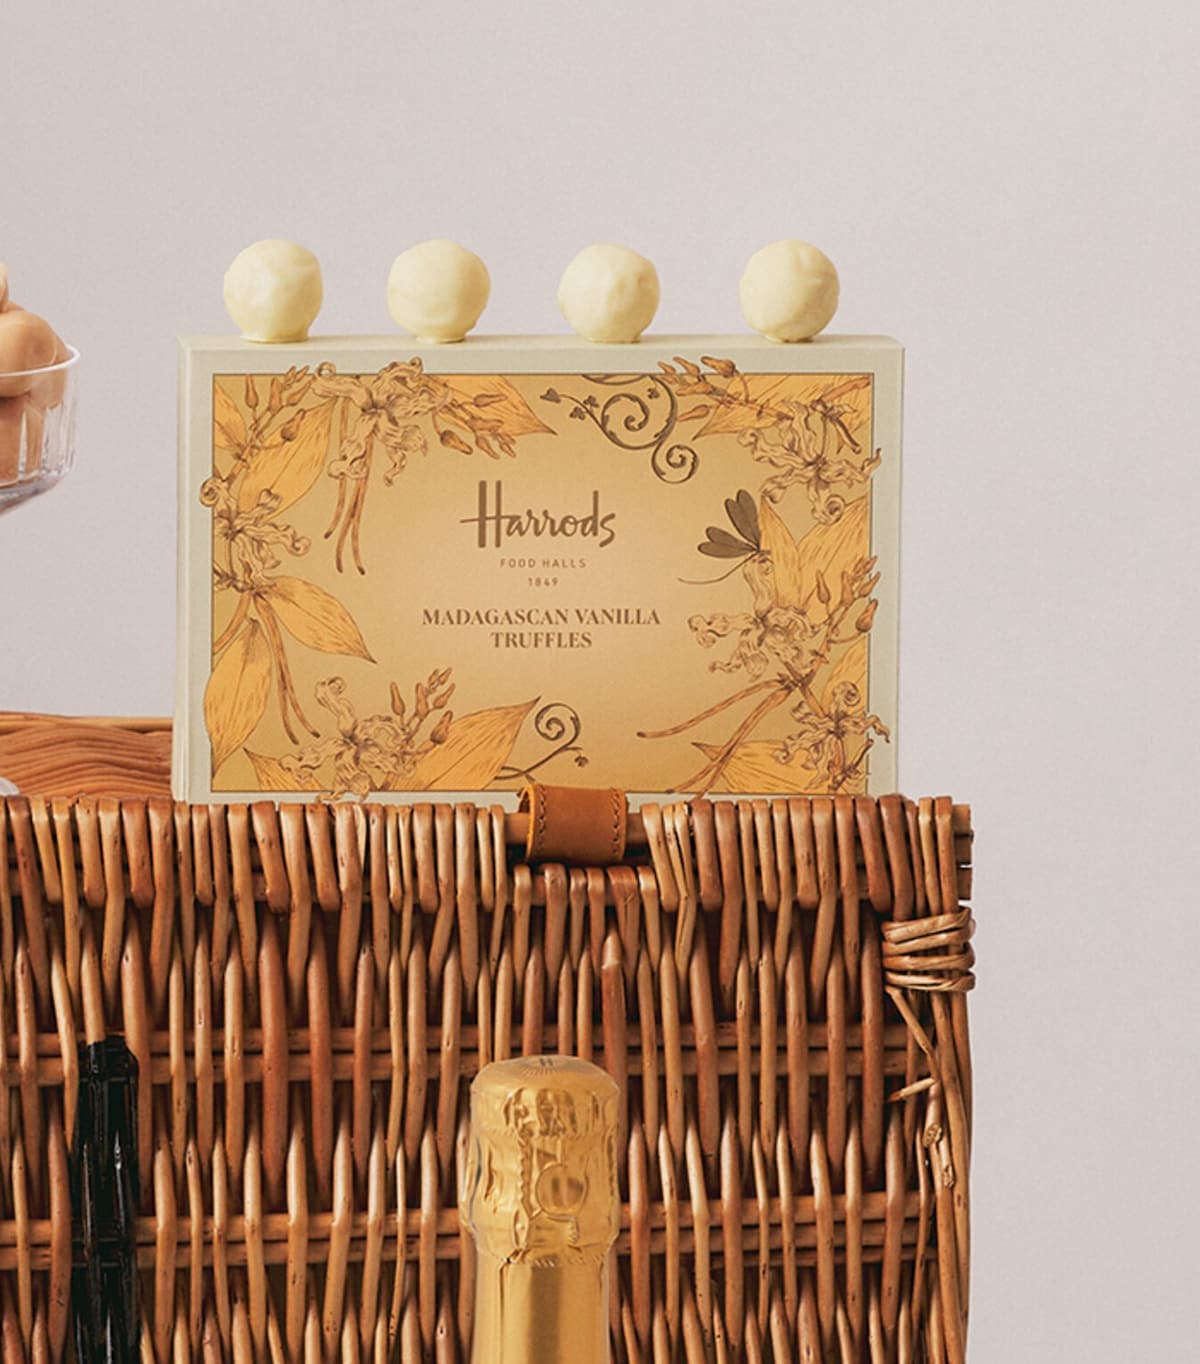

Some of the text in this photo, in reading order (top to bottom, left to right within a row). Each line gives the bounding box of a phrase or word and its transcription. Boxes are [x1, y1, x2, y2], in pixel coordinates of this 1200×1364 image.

[460, 480, 616, 548] Harrods
[500, 558, 587, 569] FOOD HALLS
[528, 577, 559, 588] 1849
[422, 608, 661, 626] MADAGASCAN VANILLA
[490, 631, 593, 649] TRUFFLES
